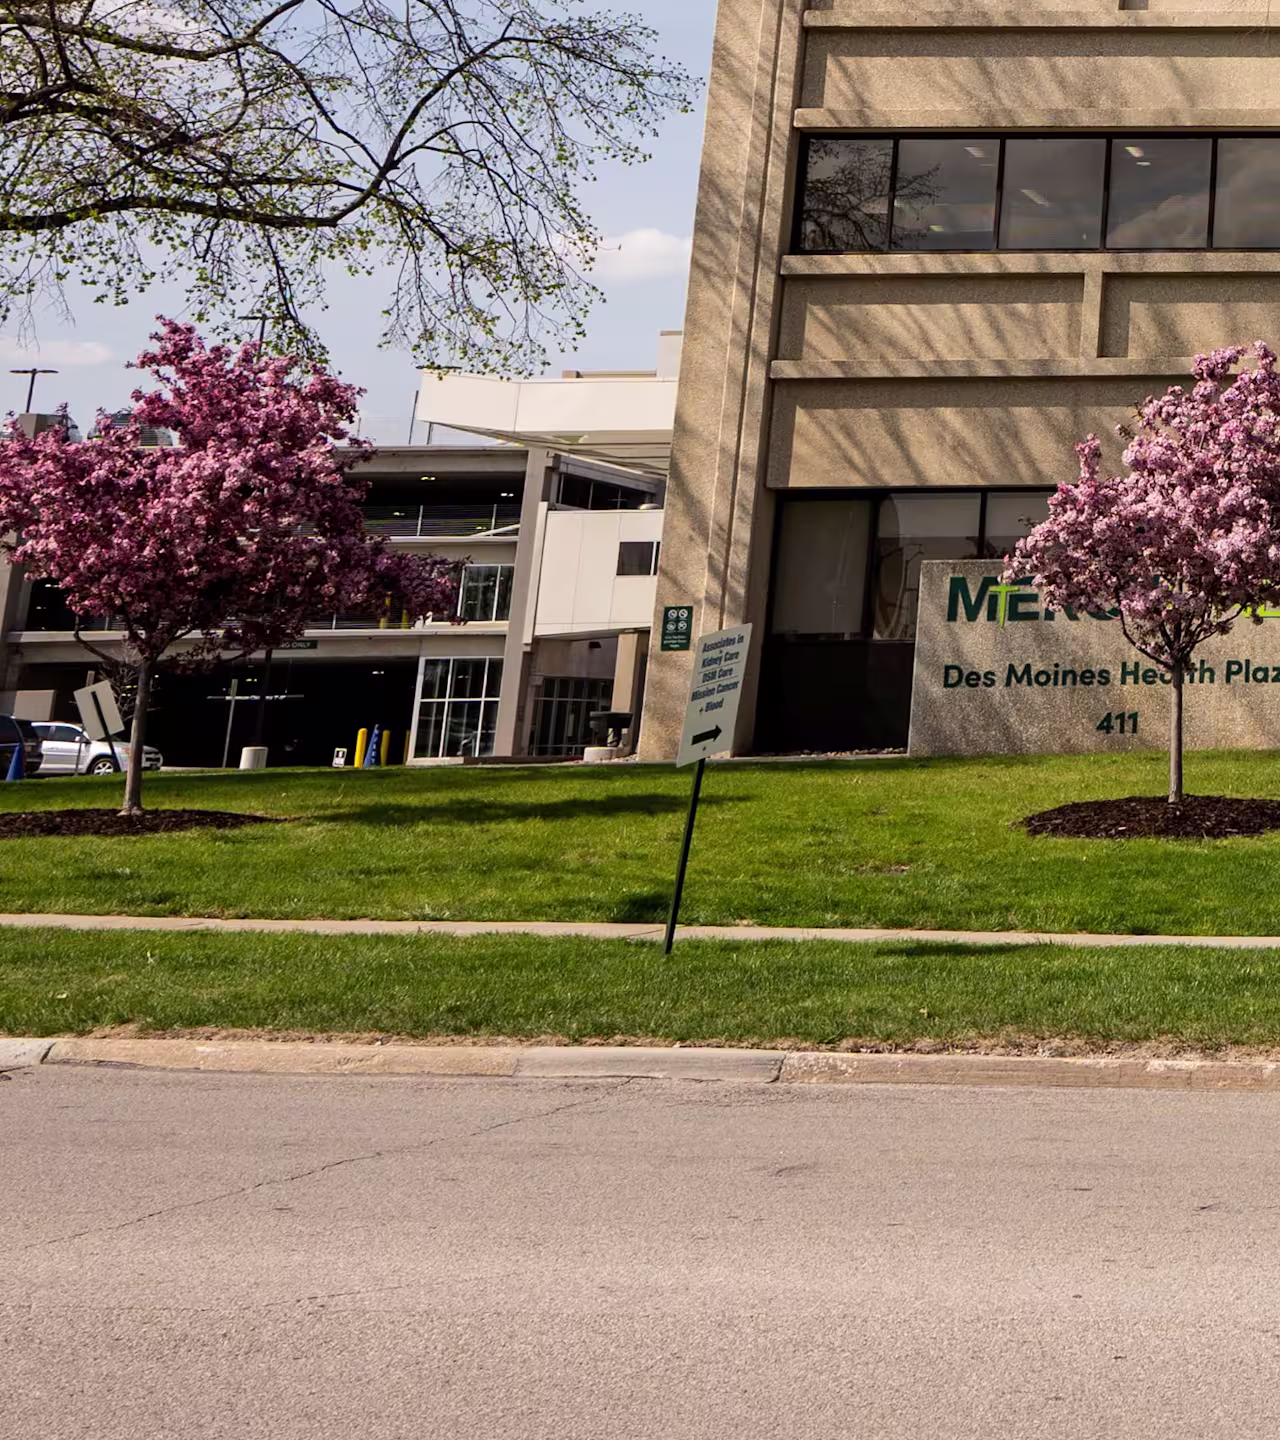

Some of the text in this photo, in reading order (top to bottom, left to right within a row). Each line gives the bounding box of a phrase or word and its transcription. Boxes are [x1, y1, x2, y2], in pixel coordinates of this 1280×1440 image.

[702, 637, 736, 653] Associates
[737, 634, 744, 644] in
[702, 651, 739, 668] Kidney Care
[718, 668, 733, 678] Care
[943, 664, 996, 688] Des
[1005, 663, 1111, 687] Moines
[691, 681, 739, 702] Mission Cancer
[705, 697, 724, 712] Blood
[1096, 711, 1138, 734] 411
